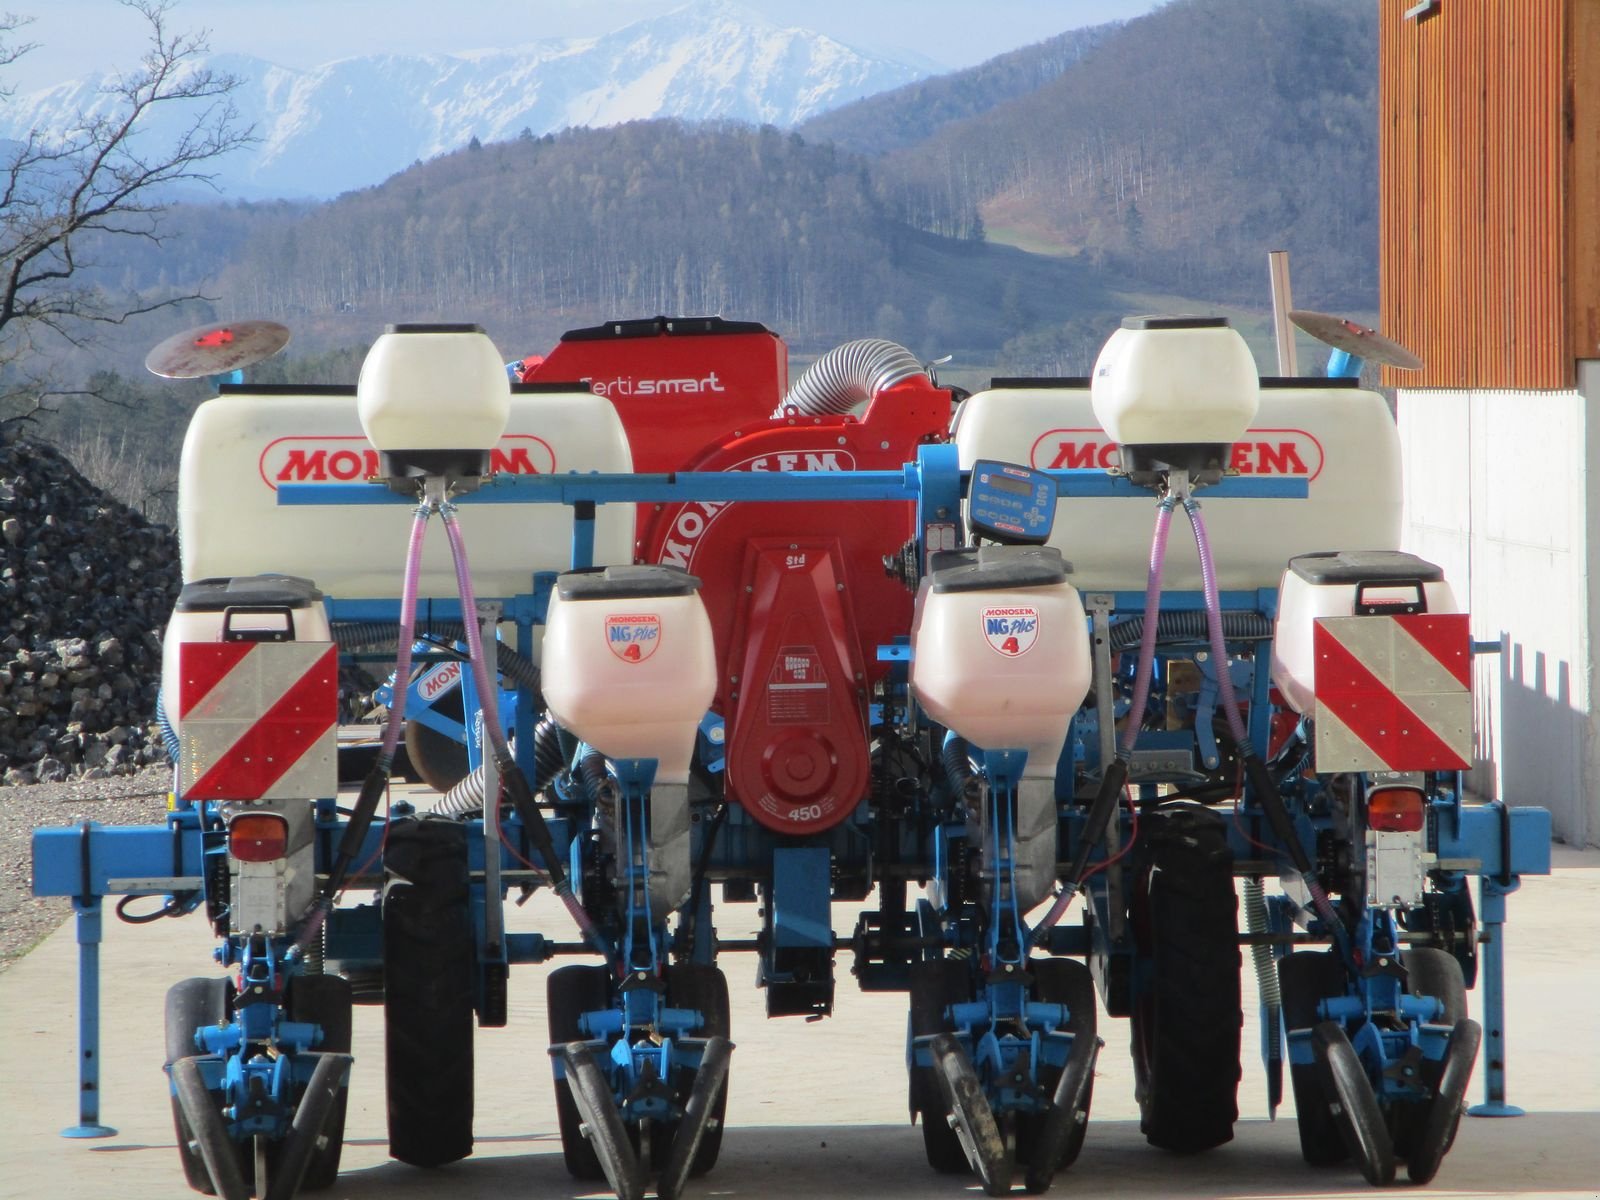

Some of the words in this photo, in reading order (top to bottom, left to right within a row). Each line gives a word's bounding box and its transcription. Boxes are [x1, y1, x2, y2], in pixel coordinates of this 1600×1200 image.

[580, 371, 725, 396] ertismart
[785, 553, 806, 569] Std
[986, 608, 1035, 616] MONOSEM
[611, 626, 631, 642] NG
[987, 618, 1009, 635] NG
[623, 643, 641, 660] 4
[1001, 636, 1020, 653] 4
[788, 804, 822, 821] 450
